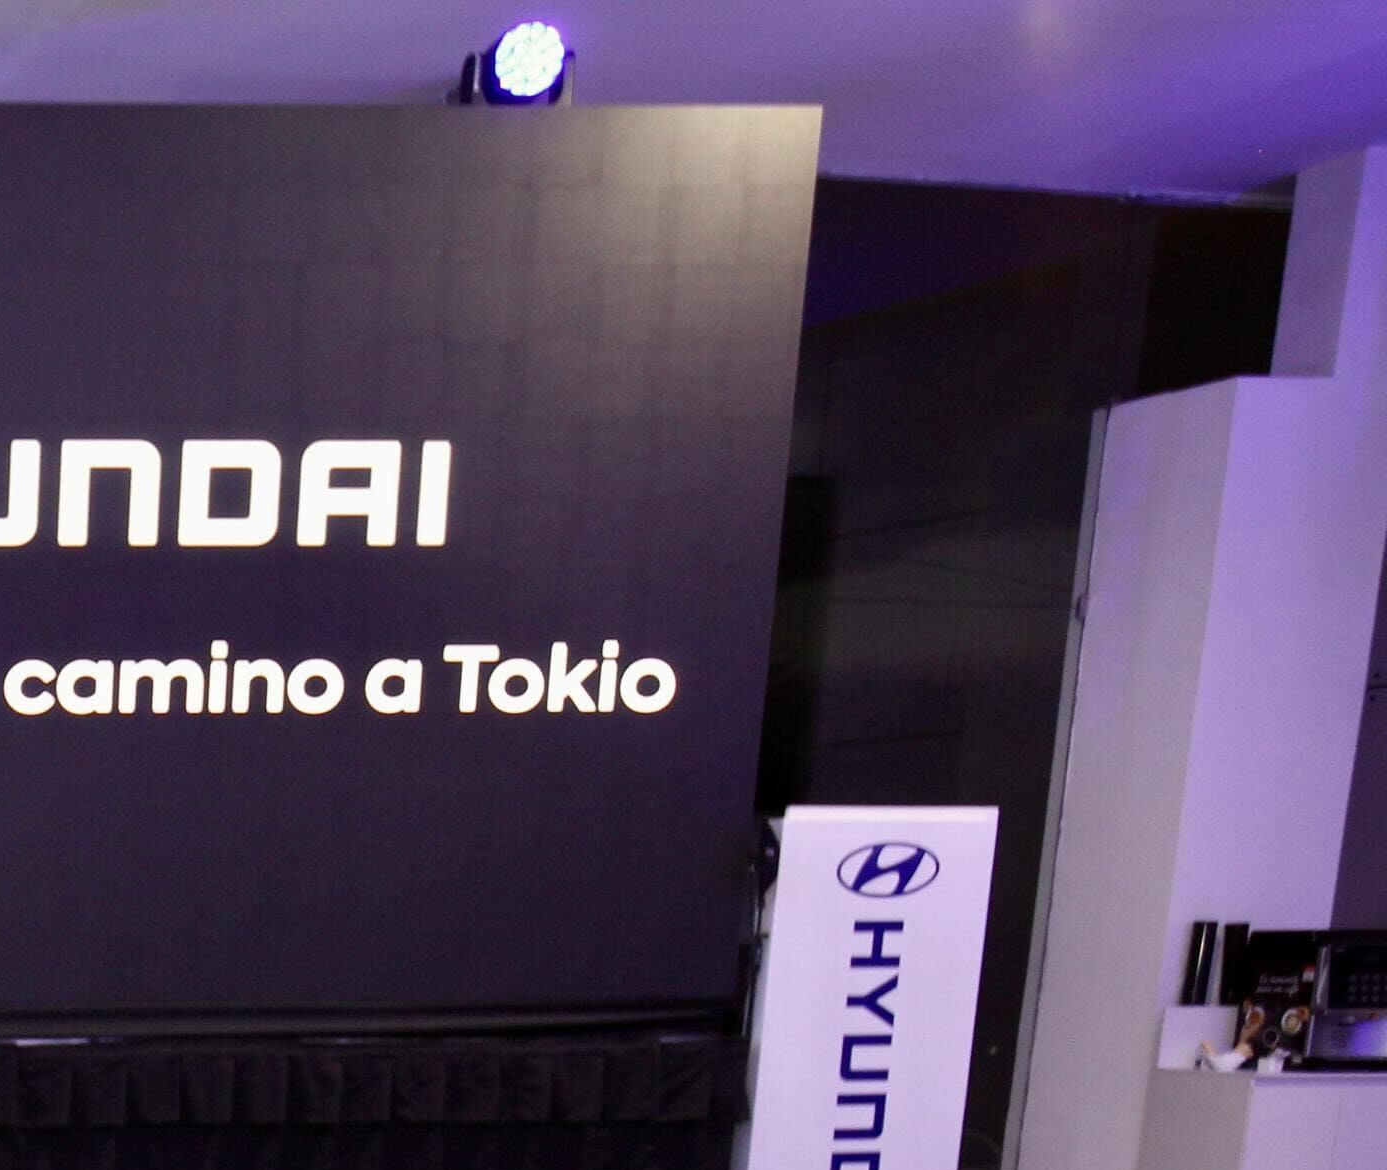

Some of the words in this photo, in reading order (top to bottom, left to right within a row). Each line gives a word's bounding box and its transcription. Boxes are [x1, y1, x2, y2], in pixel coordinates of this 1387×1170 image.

[3, 639, 345, 716] camino
[364, 658, 423, 714] a
[442, 639, 677, 714] Tokio
